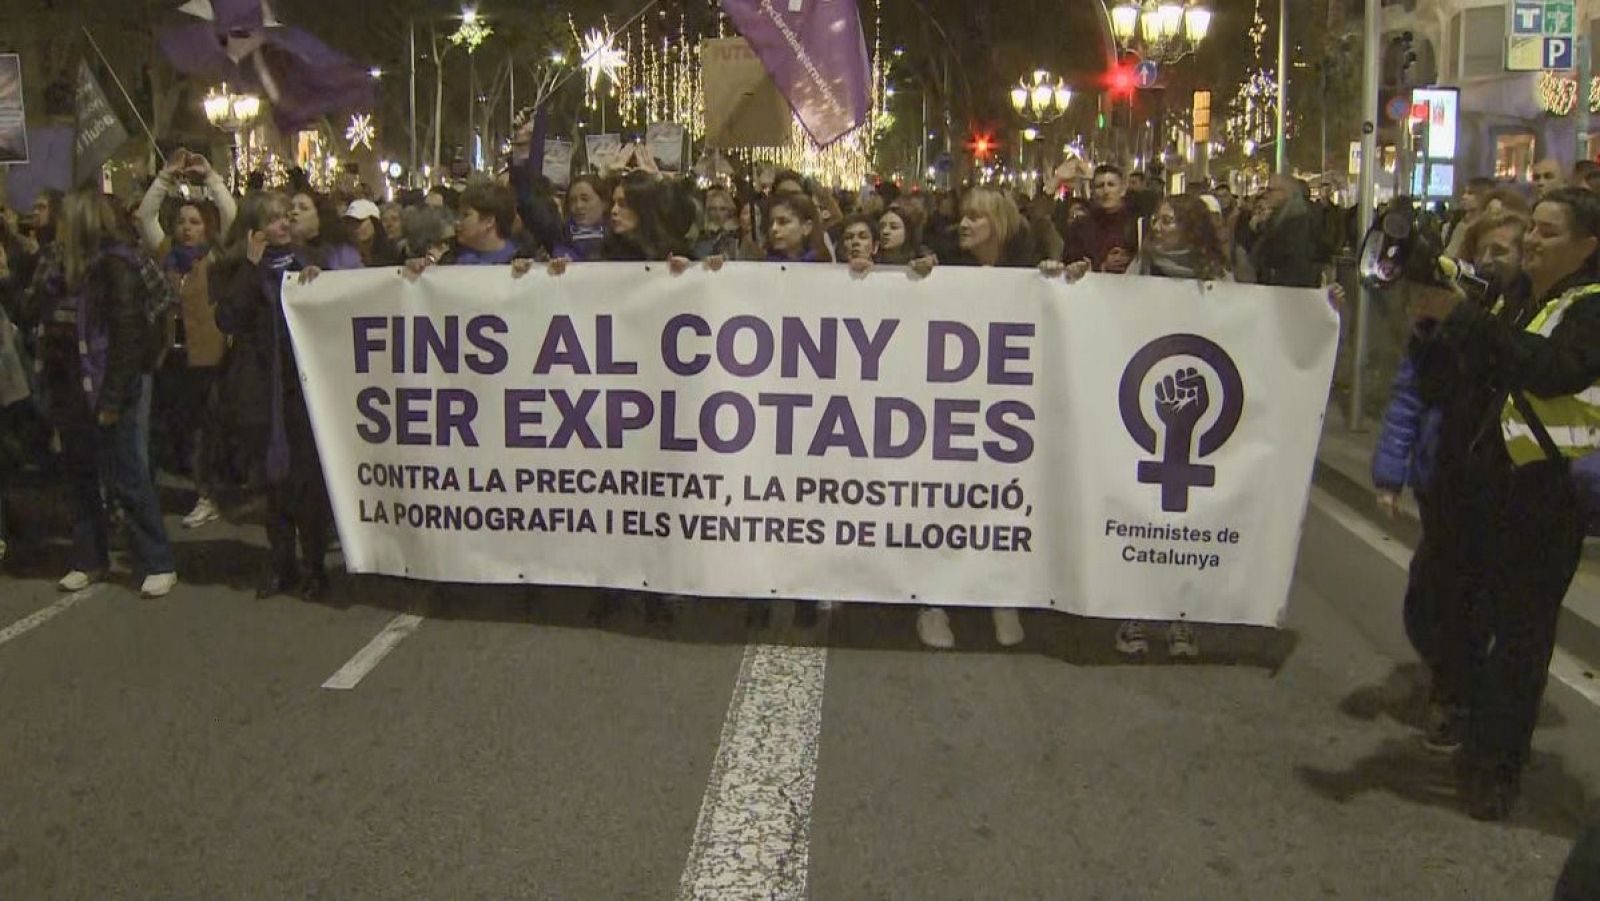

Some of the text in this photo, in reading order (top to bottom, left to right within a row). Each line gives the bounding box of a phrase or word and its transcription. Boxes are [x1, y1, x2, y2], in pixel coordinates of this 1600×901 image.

[1516, 8, 1540, 28] T
[1548, 39, 1565, 67] P
[352, 313, 1036, 386] FINS AL CONY DE
[356, 387, 1036, 464] SER EXPLOTADES
[357, 462, 1033, 517] CONTRA LA PRECARIETAT, LA PROSTITUCIÓ,
[359, 500, 1033, 552] LA PORNOGRAFIA I ELS VENTRES DE LLOGUER
[1105, 519, 1240, 544] Feministes de
[1121, 545, 1220, 570] Catalunya
